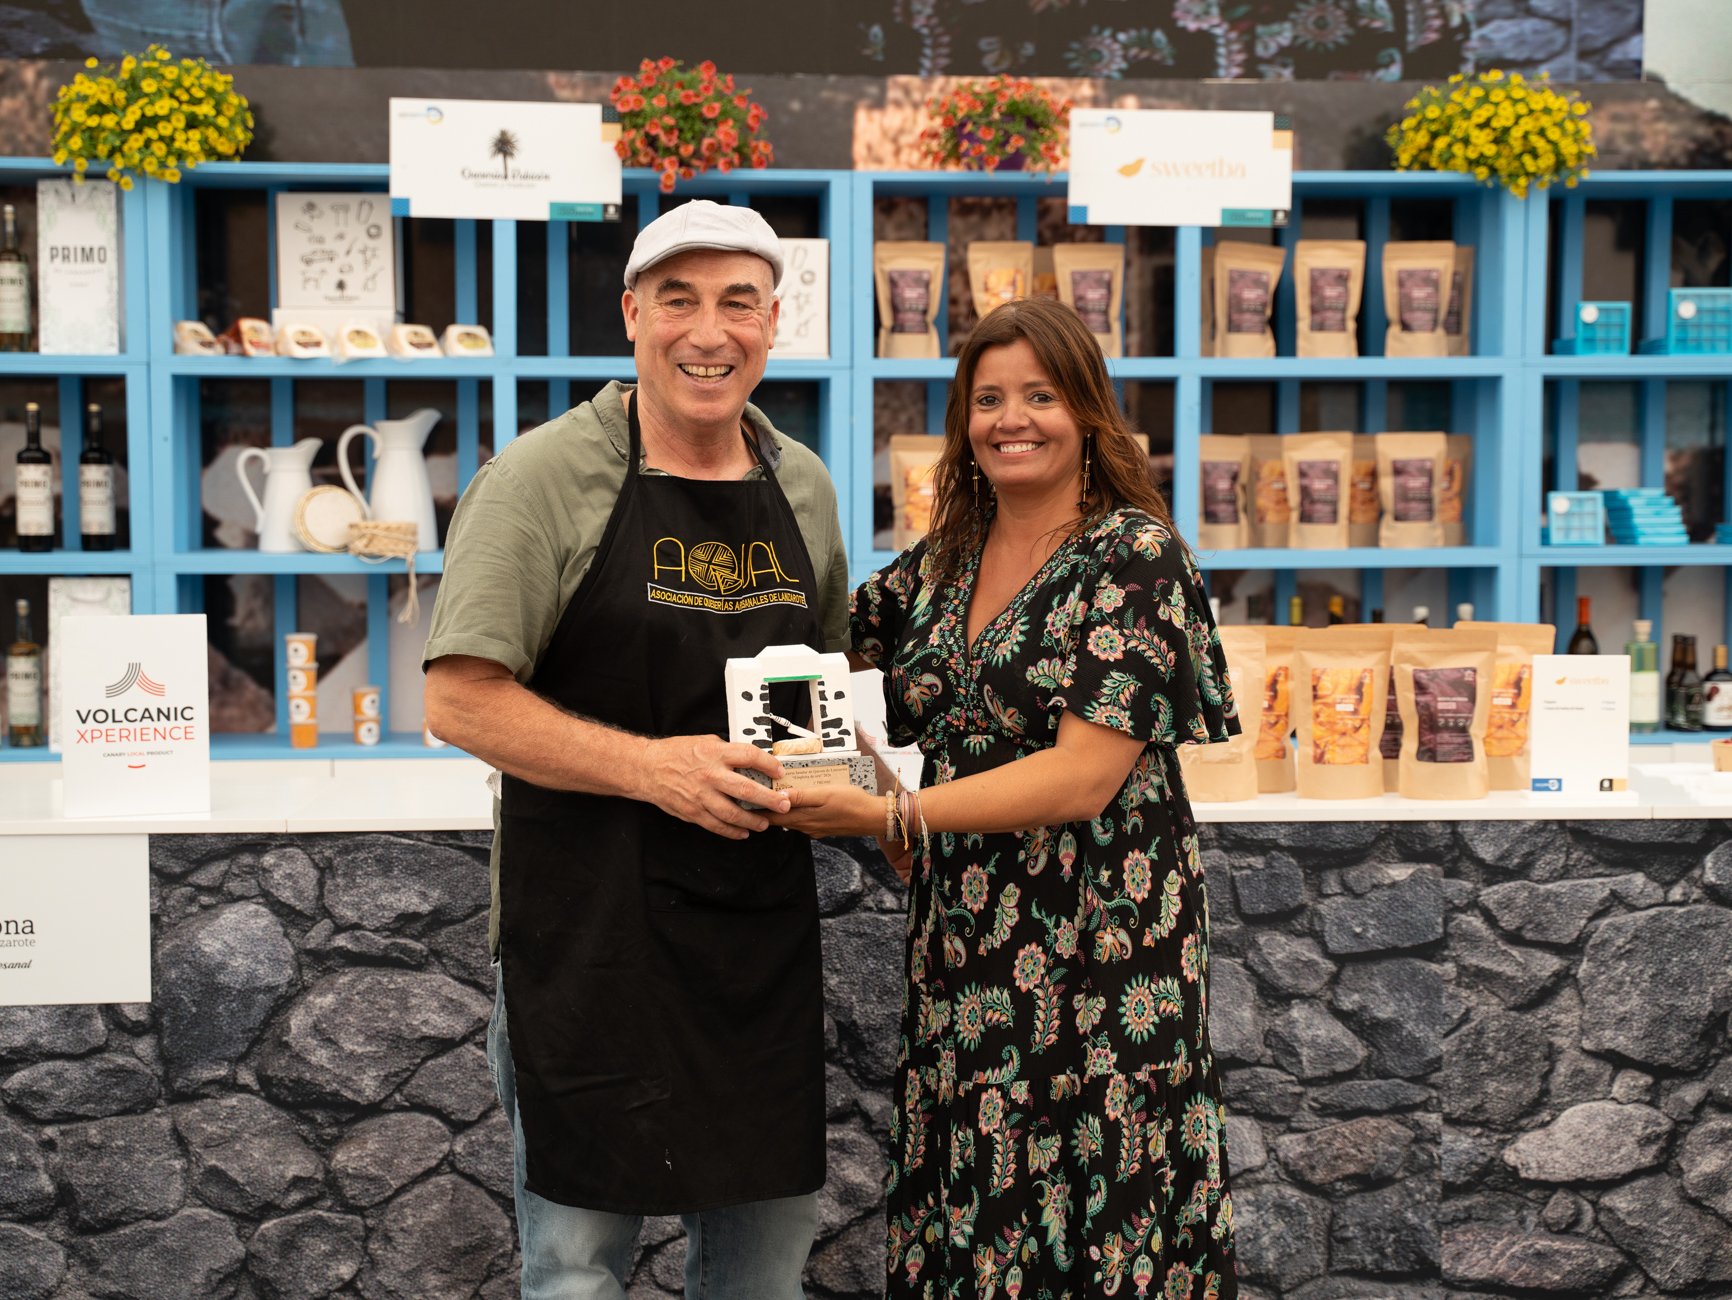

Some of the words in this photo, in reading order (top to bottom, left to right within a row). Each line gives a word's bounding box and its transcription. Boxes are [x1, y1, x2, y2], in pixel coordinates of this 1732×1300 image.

[50, 246, 108, 263] PRIMO
[650, 588, 694, 605] ASOCIACIÓN
[694, 596, 704, 606] DE
[768, 592, 779, 603] DE
[76, 706, 195, 724] VOLCANIC
[76, 725, 195, 744] XPERIENCE
[0, 919, 35, 935] na
